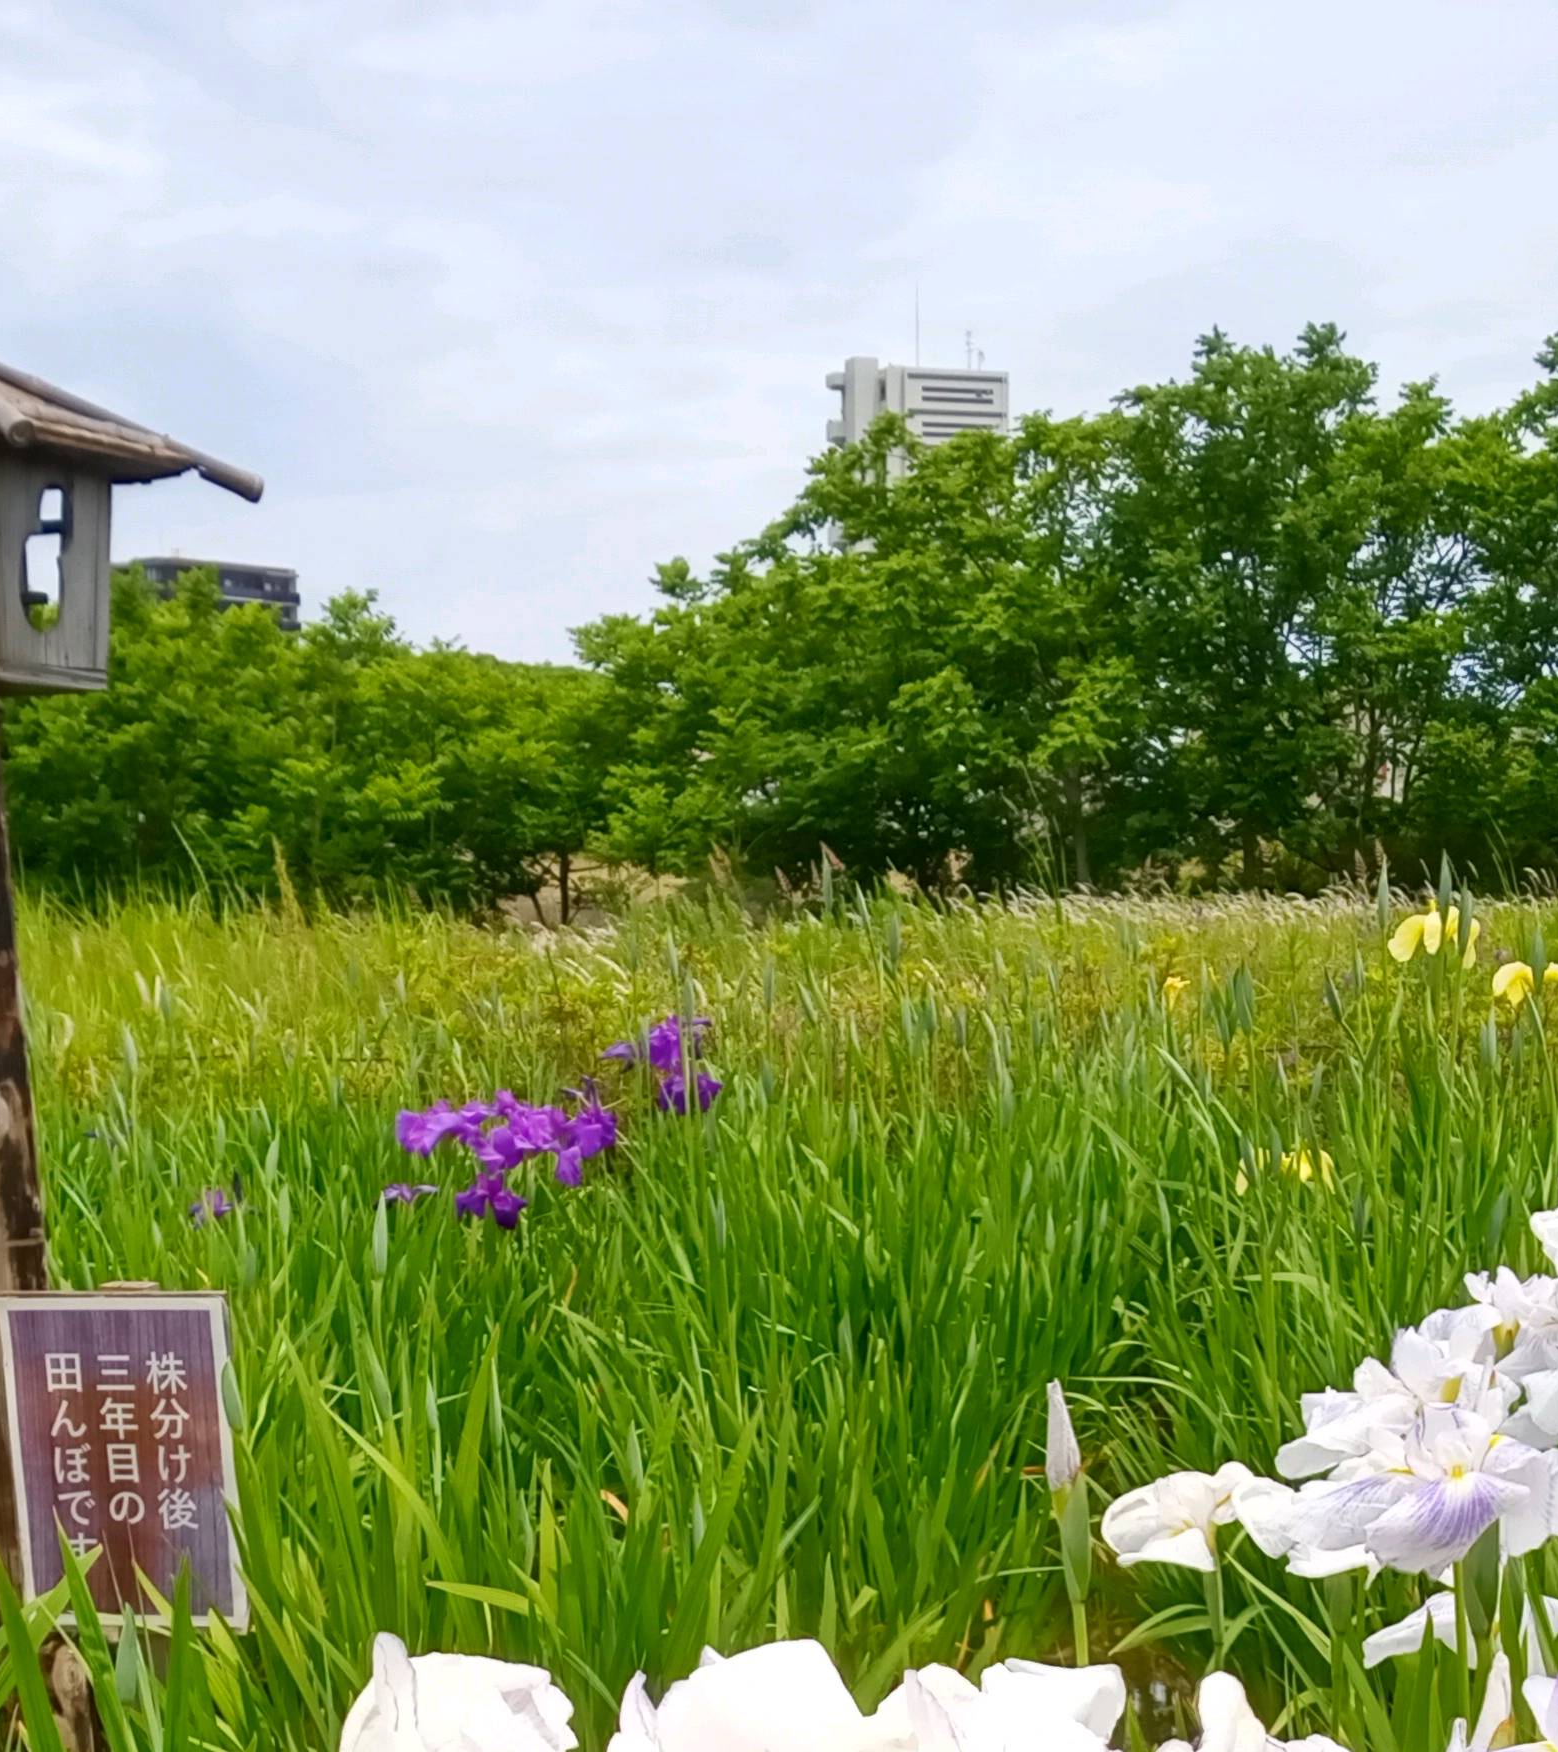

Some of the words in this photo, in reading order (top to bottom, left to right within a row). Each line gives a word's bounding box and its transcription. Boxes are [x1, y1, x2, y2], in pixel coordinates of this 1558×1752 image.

[96, 1355, 145, 1525] 三年目の
[146, 1351, 199, 1530] 株分け後
